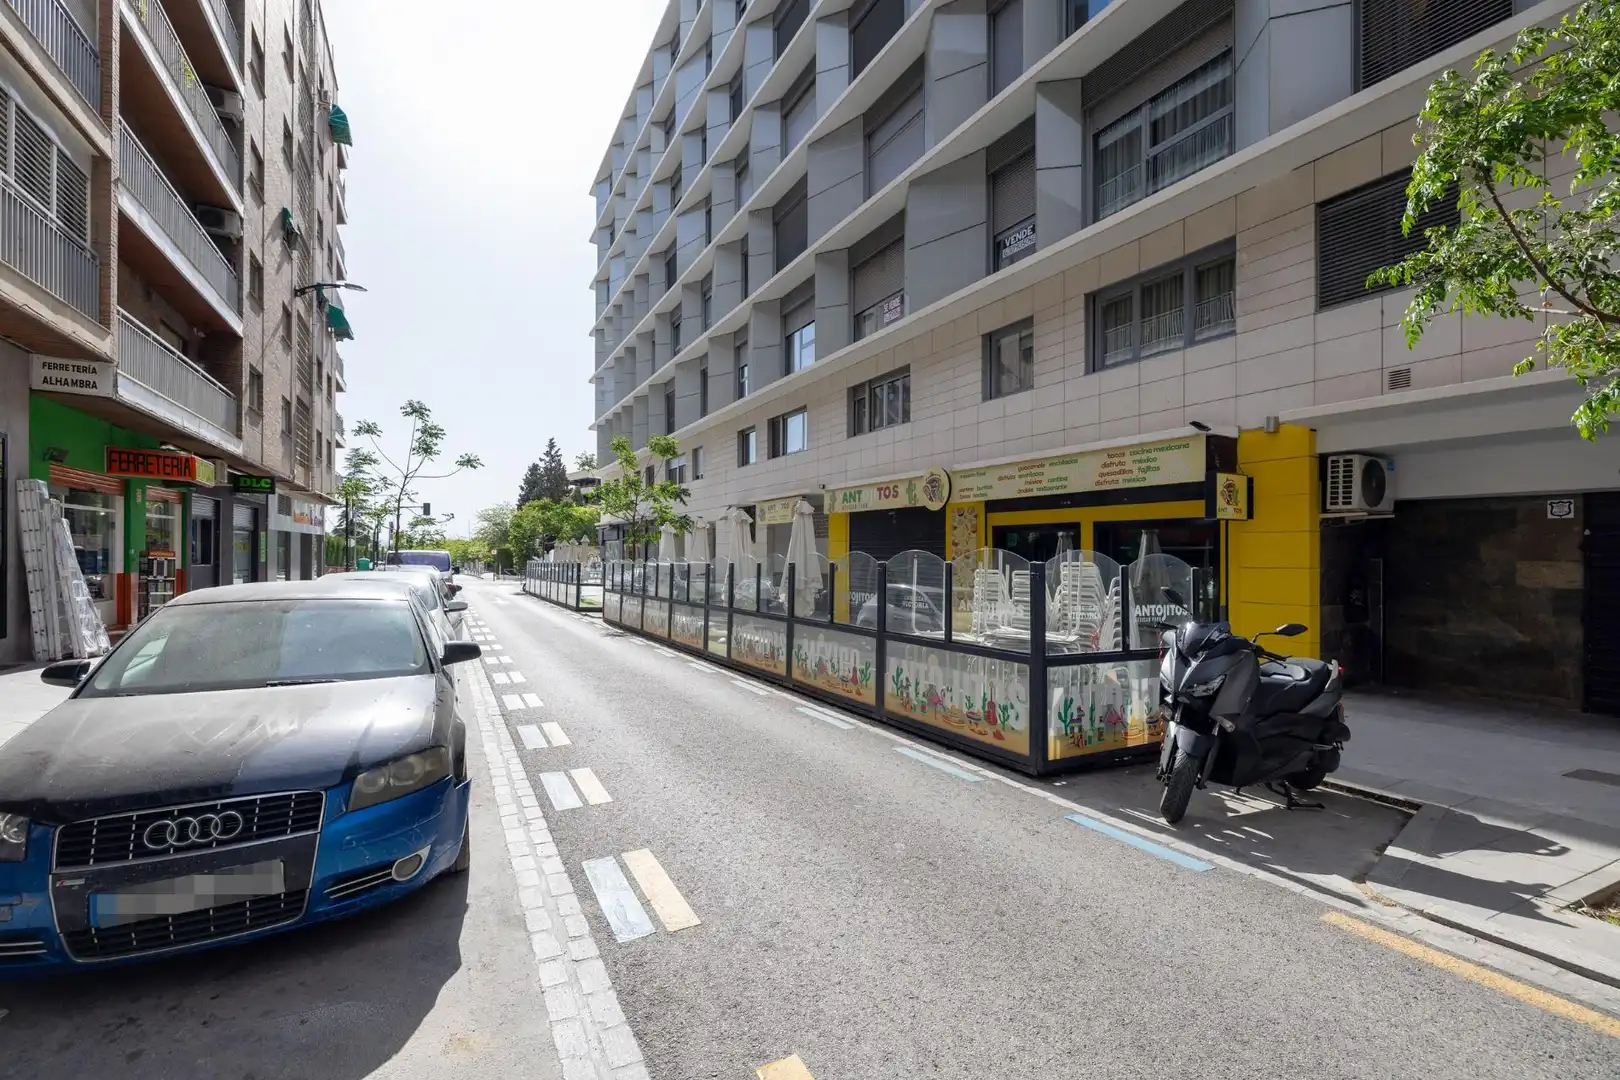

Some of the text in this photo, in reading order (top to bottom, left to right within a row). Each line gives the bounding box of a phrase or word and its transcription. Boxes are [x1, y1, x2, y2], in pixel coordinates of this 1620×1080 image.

[1005, 224, 1034, 247] VENDE
[42, 361, 98, 375] FERRETERÍA
[42, 376, 98, 390] ALHAMBRA
[1107, 442, 1190, 459] tacos cocina mexicana
[109, 449, 191, 477] FERRETERIA
[1100, 460, 1126, 469] disfruta
[1098, 465, 1161, 479] quesadillas fajitas
[240, 477, 272, 488] DLC
[1094, 478, 1120, 487] disfruta
[1135, 604, 1188, 621] ANTOJITOS
